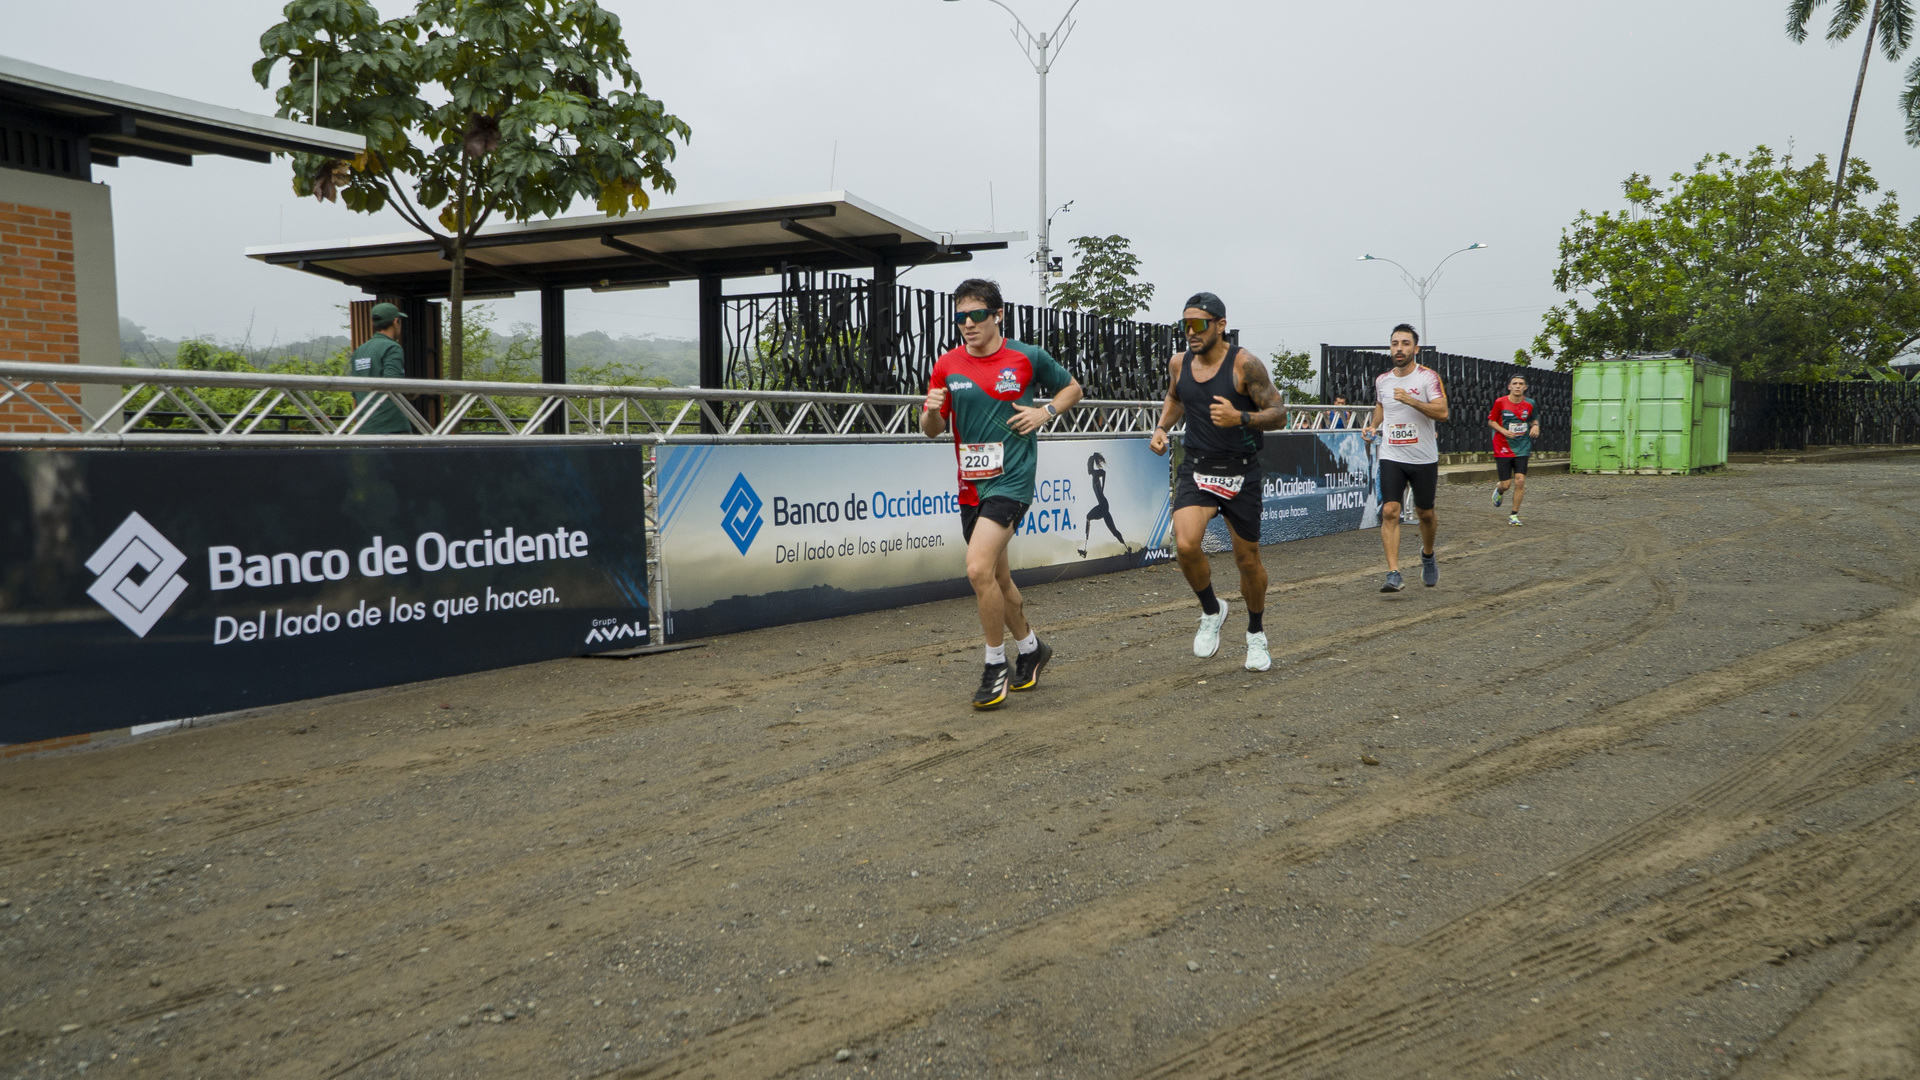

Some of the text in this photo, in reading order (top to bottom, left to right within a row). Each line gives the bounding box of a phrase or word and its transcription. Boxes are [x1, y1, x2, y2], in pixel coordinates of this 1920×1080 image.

[1391, 429, 1413, 439] 1804
[965, 455, 990, 468] 220
[1263, 477, 1316, 498] de Occidente
[1325, 471, 1366, 489] TU HACER,
[774, 490, 960, 526] Banco de Occidente
[1326, 491, 1367, 512] IMPACTA.
[1260, 505, 1309, 521] de los que hacen.
[208, 526, 589, 591] Banco de Occidente
[776, 532, 945, 564] Del lado de los que hacen.
[1145, 548, 1169, 561] AVAL
[213, 586, 561, 645] Del lado de los que hacen.
[592, 617, 617, 627] Grupo
[584, 621, 647, 645] AVAL
